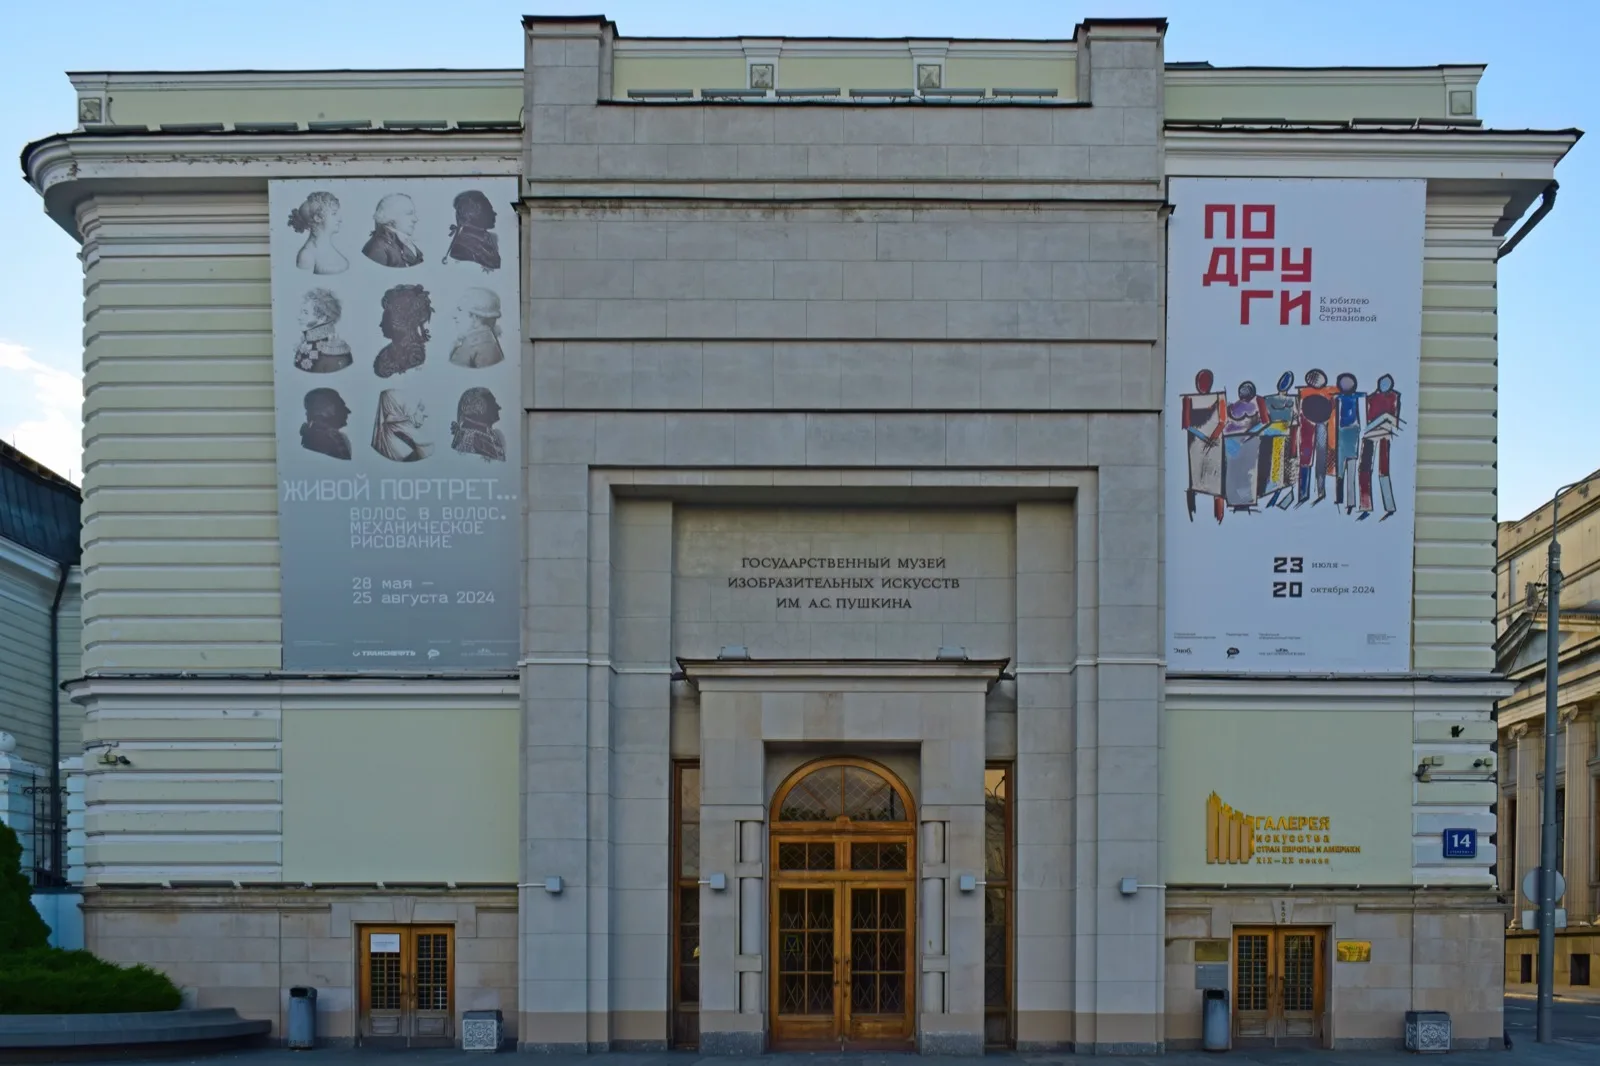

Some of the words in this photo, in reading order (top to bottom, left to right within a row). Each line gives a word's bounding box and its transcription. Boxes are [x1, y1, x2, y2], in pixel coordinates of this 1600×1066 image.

[1204, 204, 1275, 239] ПО
[1202, 247, 1312, 286] ДРУ
[1240, 290, 1312, 325] ГИ
[1319, 297, 1327, 305] К
[1329, 296, 1370, 305] юбилею
[1319, 305, 1361, 315] Варвары
[1318, 314, 1377, 323] Степановой
[283, 473, 370, 501] ЖИВОЙ
[350, 507, 407, 520] ВОЛОС
[419, 507, 430, 520] В
[442, 507, 507, 520] ВОЛОС.
[350, 521, 484, 535] МЕХАНИЧЕСКОЕ
[350, 535, 452, 549] РИСОВАНИЕ
[741, 557, 891, 569] ГОСУДАРСТВЕННЫЙ
[897, 557, 947, 569] МУЗЕЙ
[1273, 557, 1303, 573] 23
[352, 577, 372, 590] 28
[382, 579, 412, 589] мая
[727, 577, 875, 589] ИЗОБРАЗИТЕЛЬНЫХ
[881, 577, 960, 589] ИСКУССТВ
[1272, 582, 1303, 598] 20
[1310, 585, 1350, 595] октября
[1352, 586, 1376, 594] 2024
[352, 591, 372, 604] 25
[381, 593, 449, 607] августа
[456, 591, 495, 604] 2024
[776, 598, 801, 609] ИМ.
[836, 598, 912, 610] ПУШКИНА
[1255, 816, 1330, 830] ГАЛЕРЕЯ
[1452, 833, 1471, 848] 14
